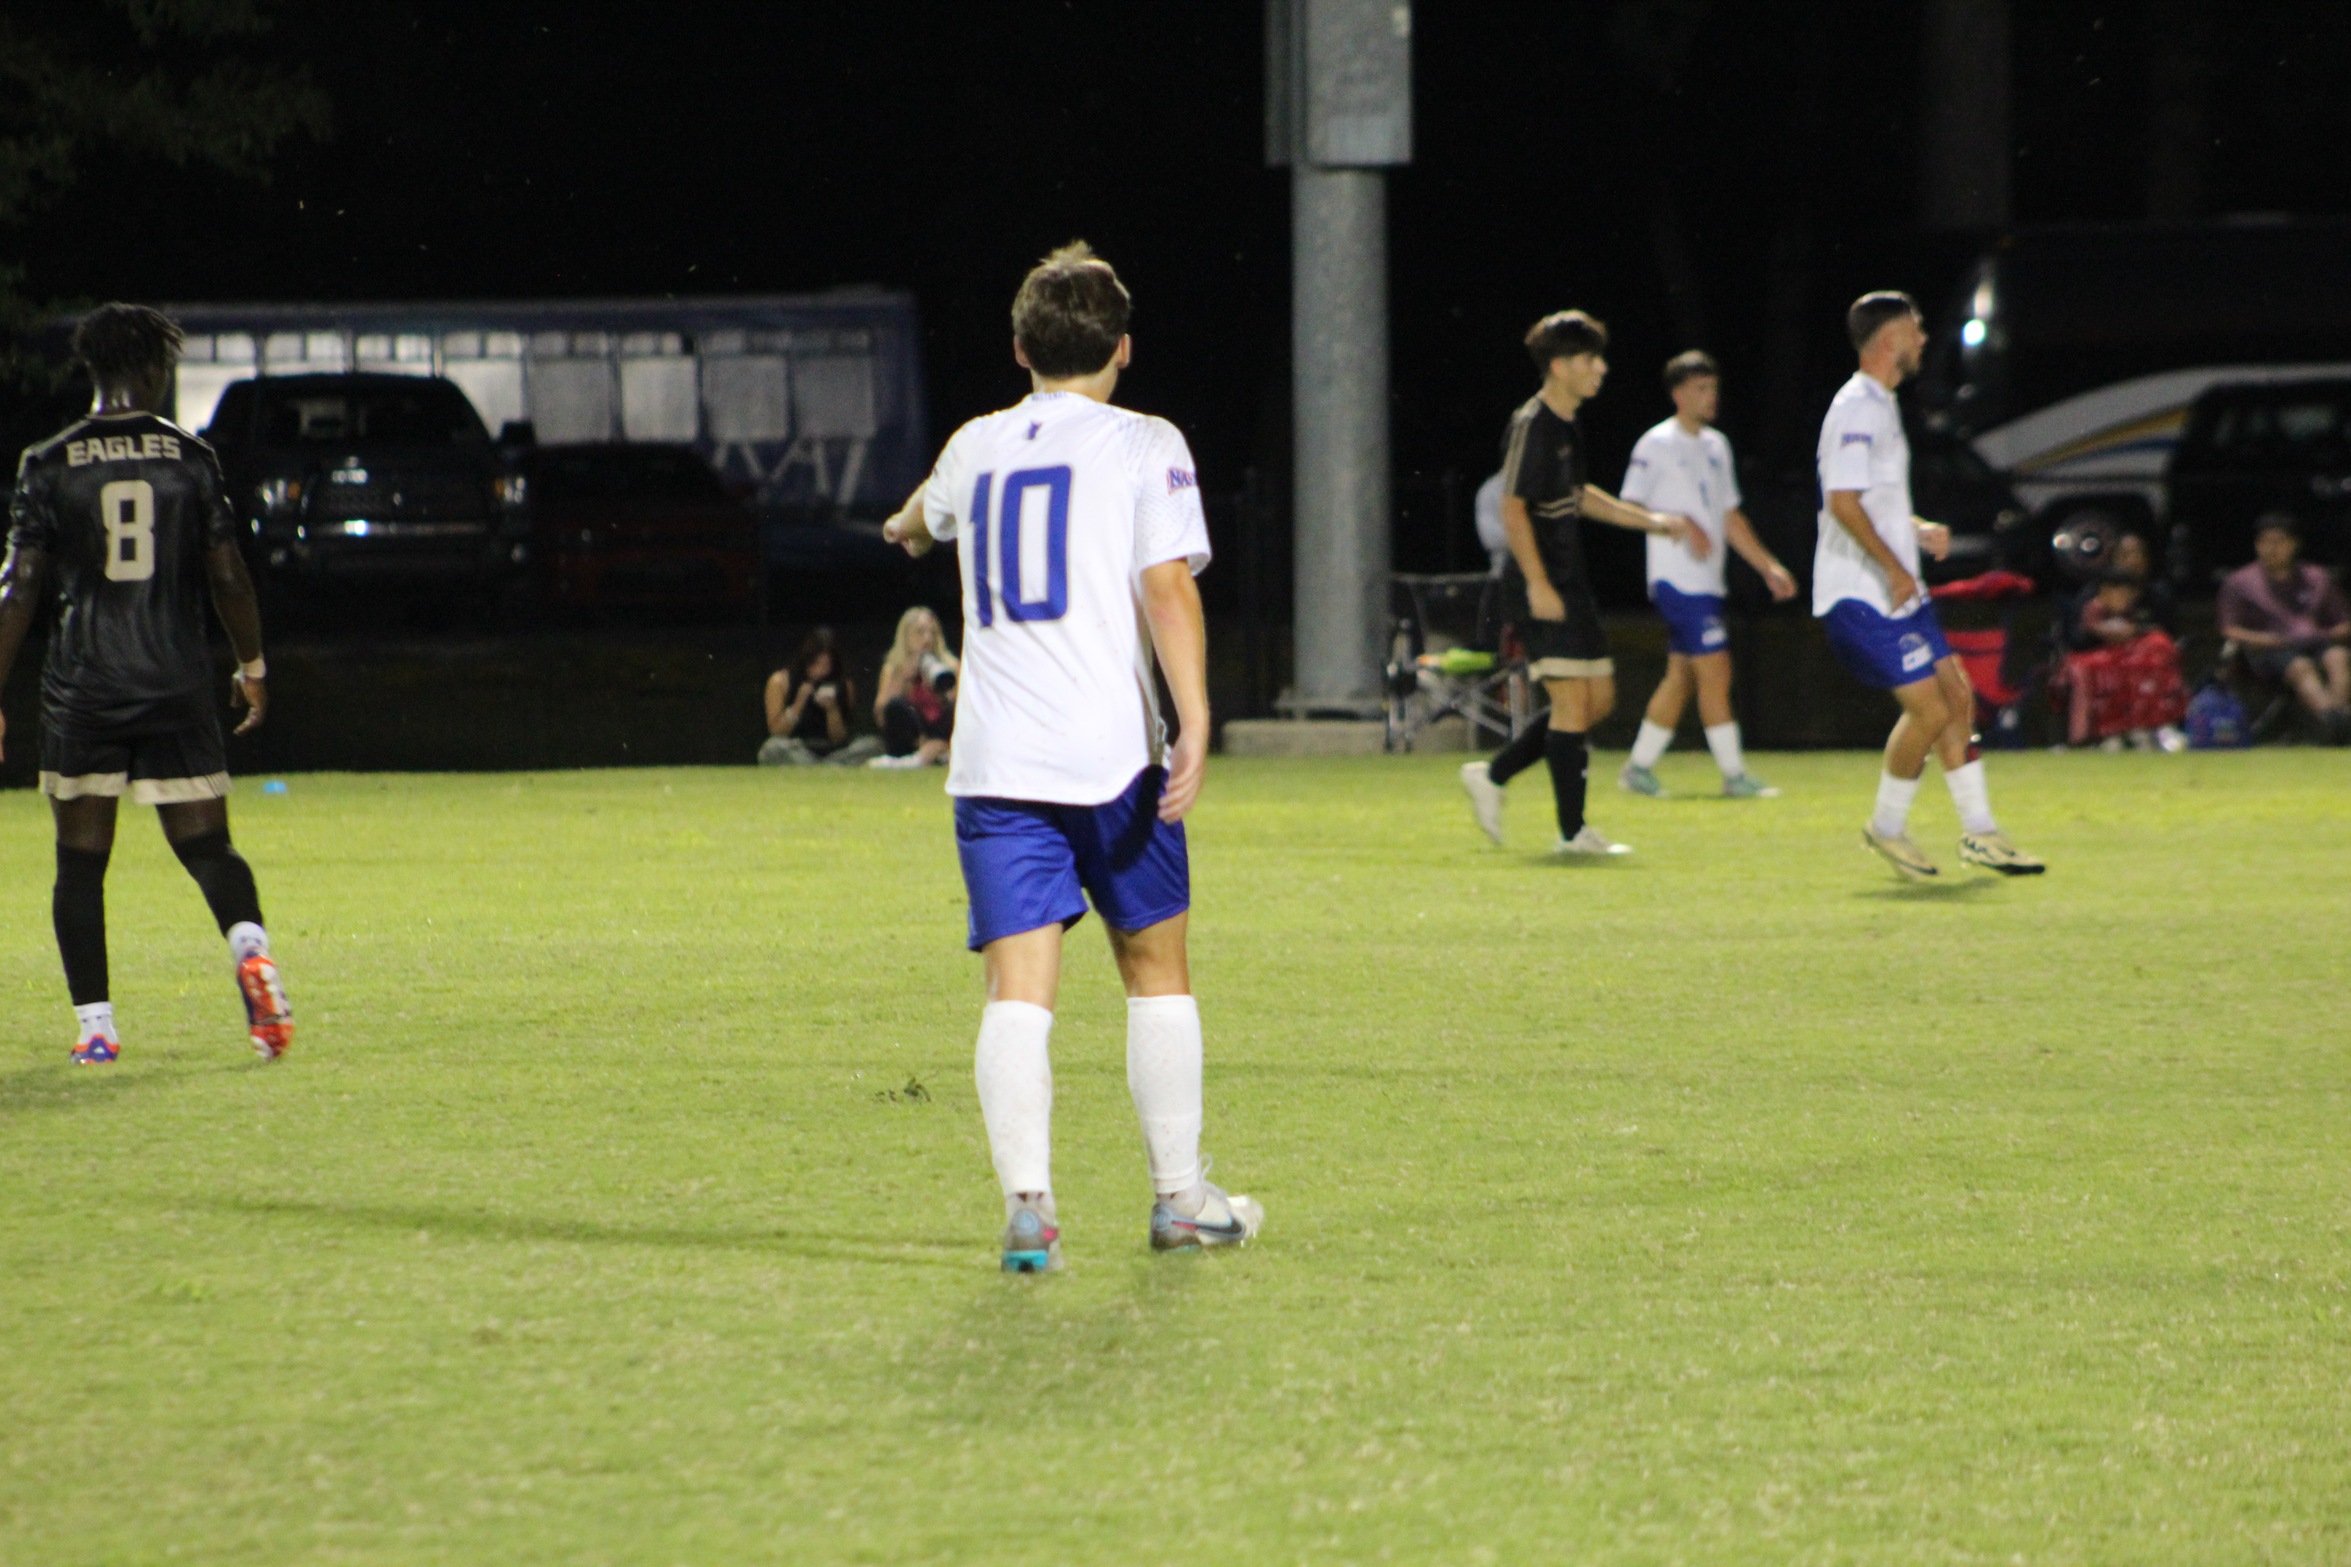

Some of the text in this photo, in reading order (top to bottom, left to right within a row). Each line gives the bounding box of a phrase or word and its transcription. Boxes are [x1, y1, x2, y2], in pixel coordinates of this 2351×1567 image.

[66, 433, 182, 468] EAGLES
[101, 479, 155, 582] 8
[969, 465, 1072, 628] 10
